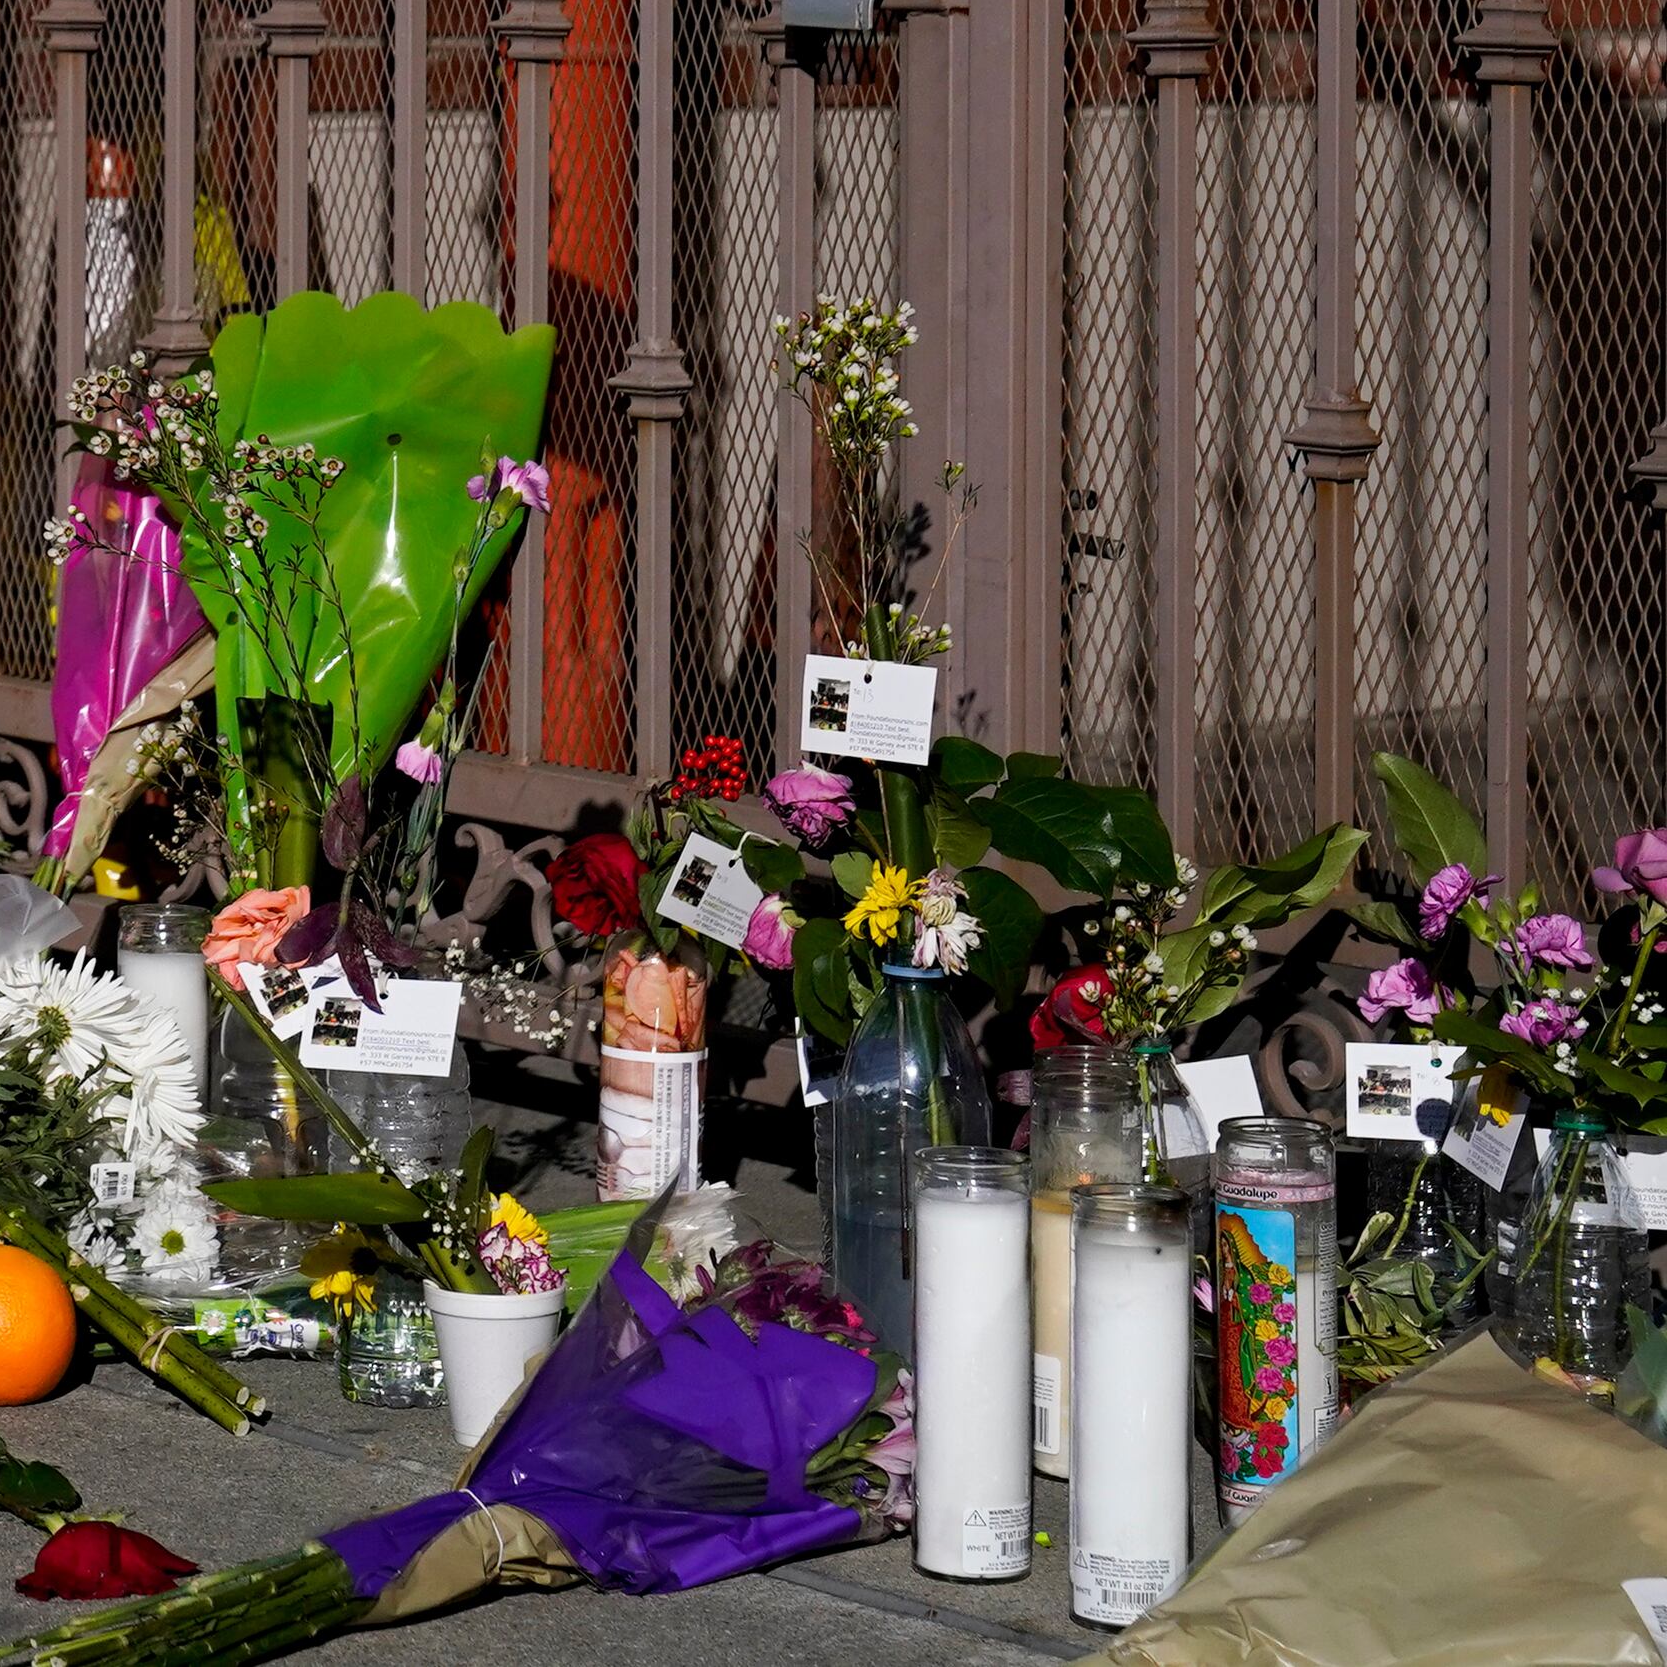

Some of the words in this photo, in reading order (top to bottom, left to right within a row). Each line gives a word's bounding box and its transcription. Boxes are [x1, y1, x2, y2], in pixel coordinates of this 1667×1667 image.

[1222, 1184, 1278, 1201] Guadalupe
[966, 1544, 990, 1552] WHITE
[1095, 1577, 1107, 1587] NET
[1109, 1579, 1121, 1589] WT
[1123, 1581, 1133, 1590] 8.1
